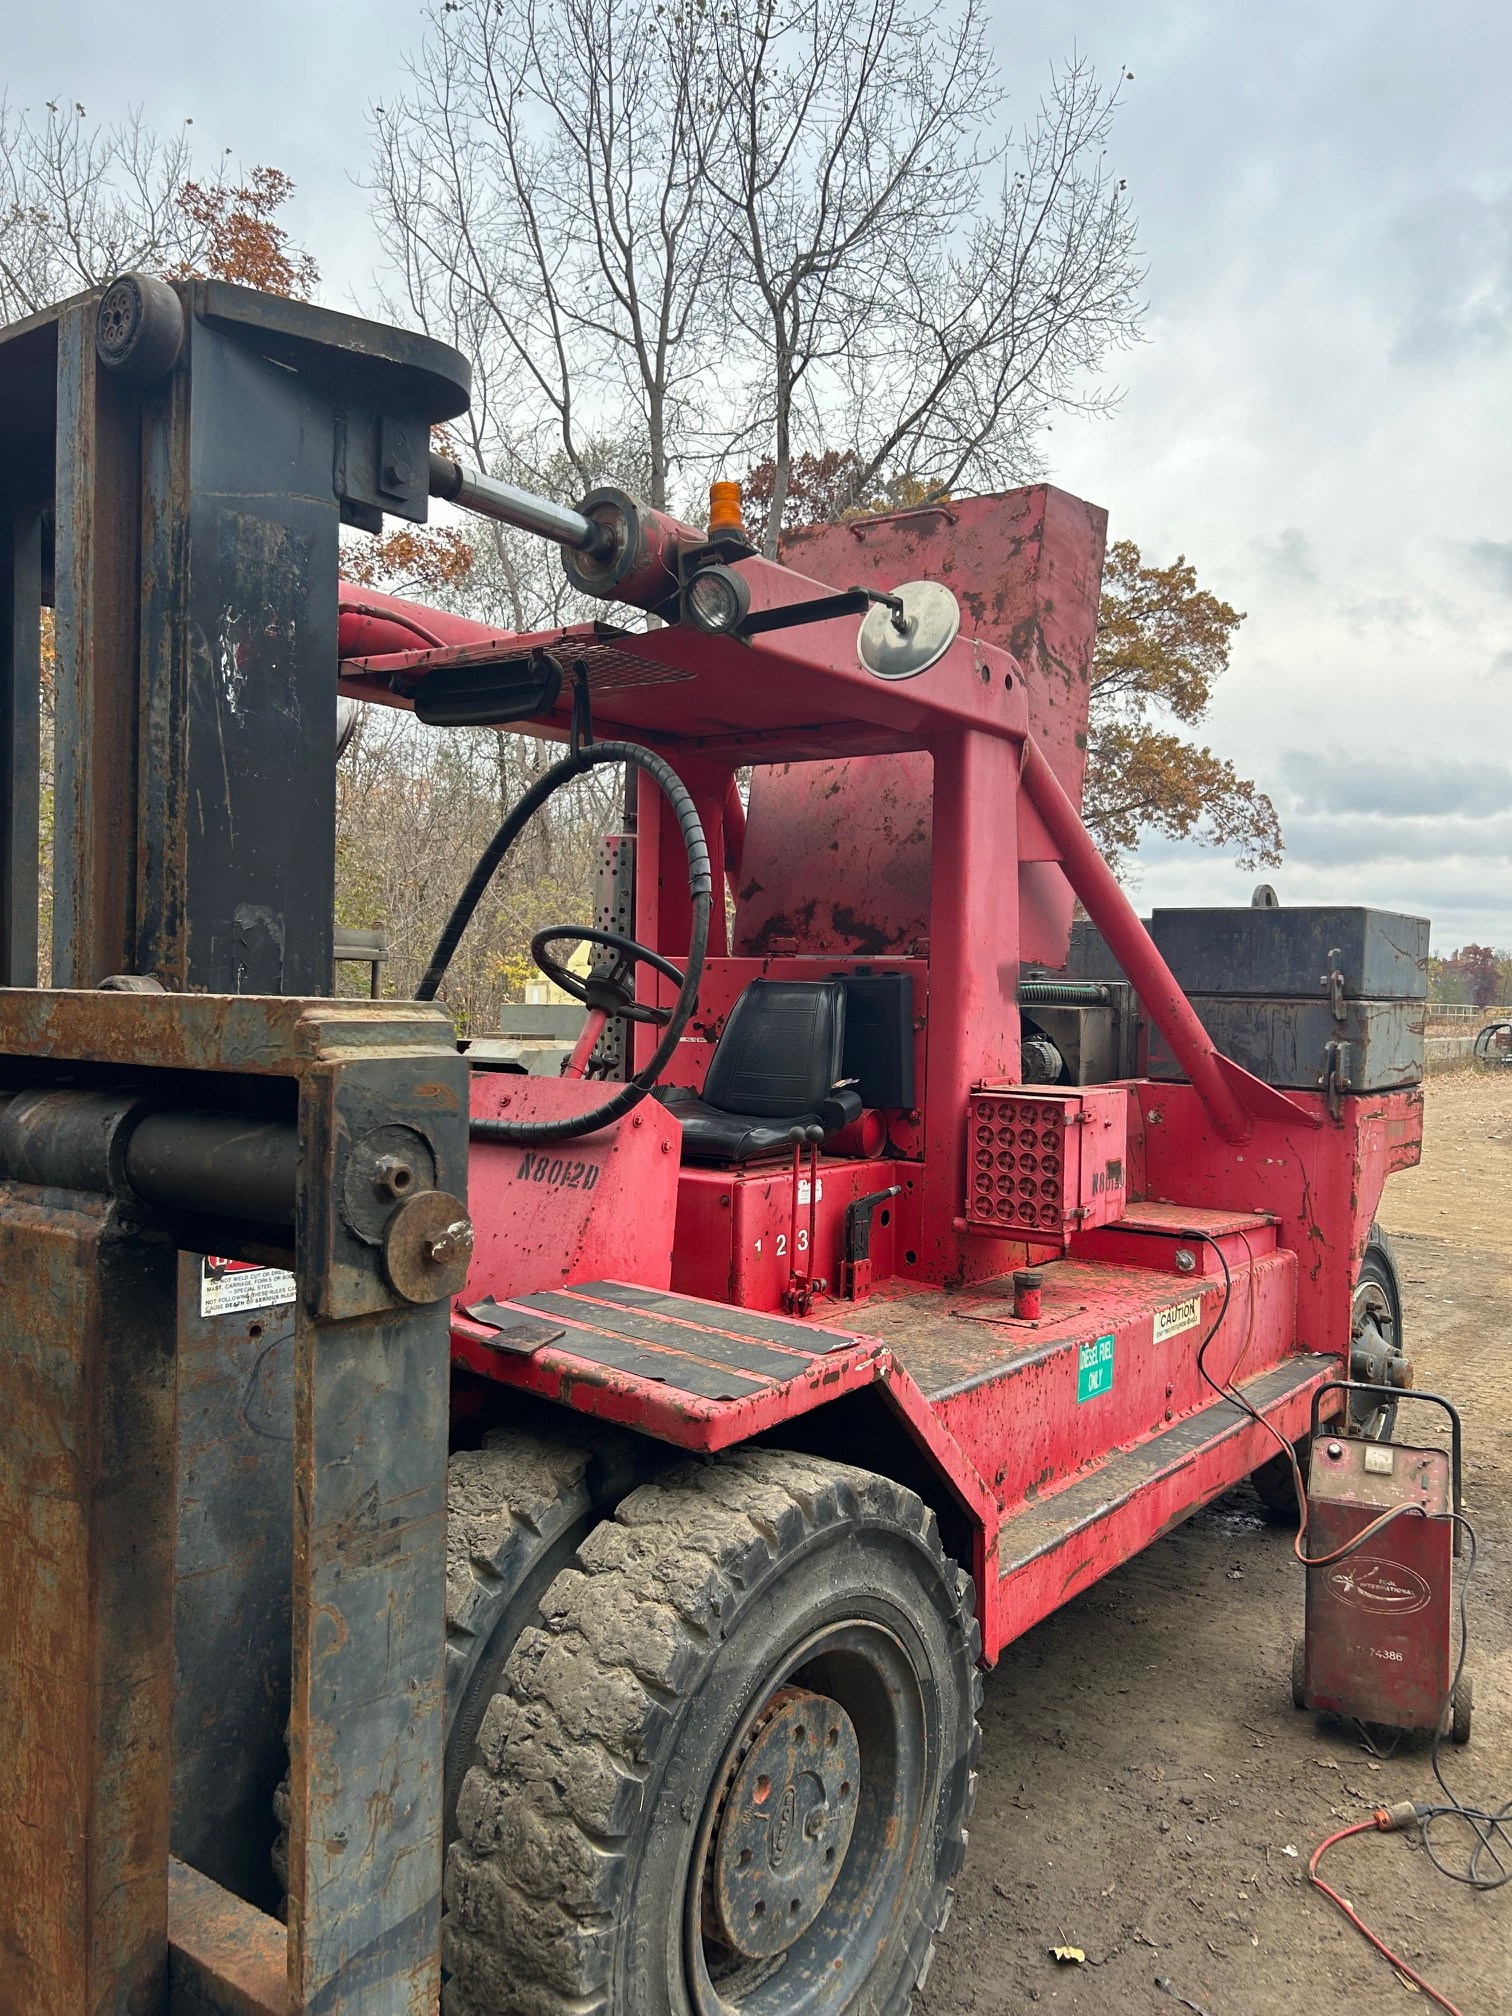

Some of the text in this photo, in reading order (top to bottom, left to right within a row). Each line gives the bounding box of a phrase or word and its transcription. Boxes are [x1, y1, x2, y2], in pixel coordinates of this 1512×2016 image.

[776, 1234, 787, 1256] 2
[797, 1229, 809, 1251] 3
[218, 1294, 249, 1303] FOLLOWING
[233, 1286, 256, 1294] SPECIAL
[225, 1300, 245, 1308] DEATH
[255, 1294, 279, 1303] SERIOUS
[1160, 1302, 1195, 1327] CAUTION
[1099, 1340, 1112, 1362] FUEL
[1088, 1368, 1104, 1392] ONLY
[1359, 1582, 1416, 1596] INTERNATIONAL
